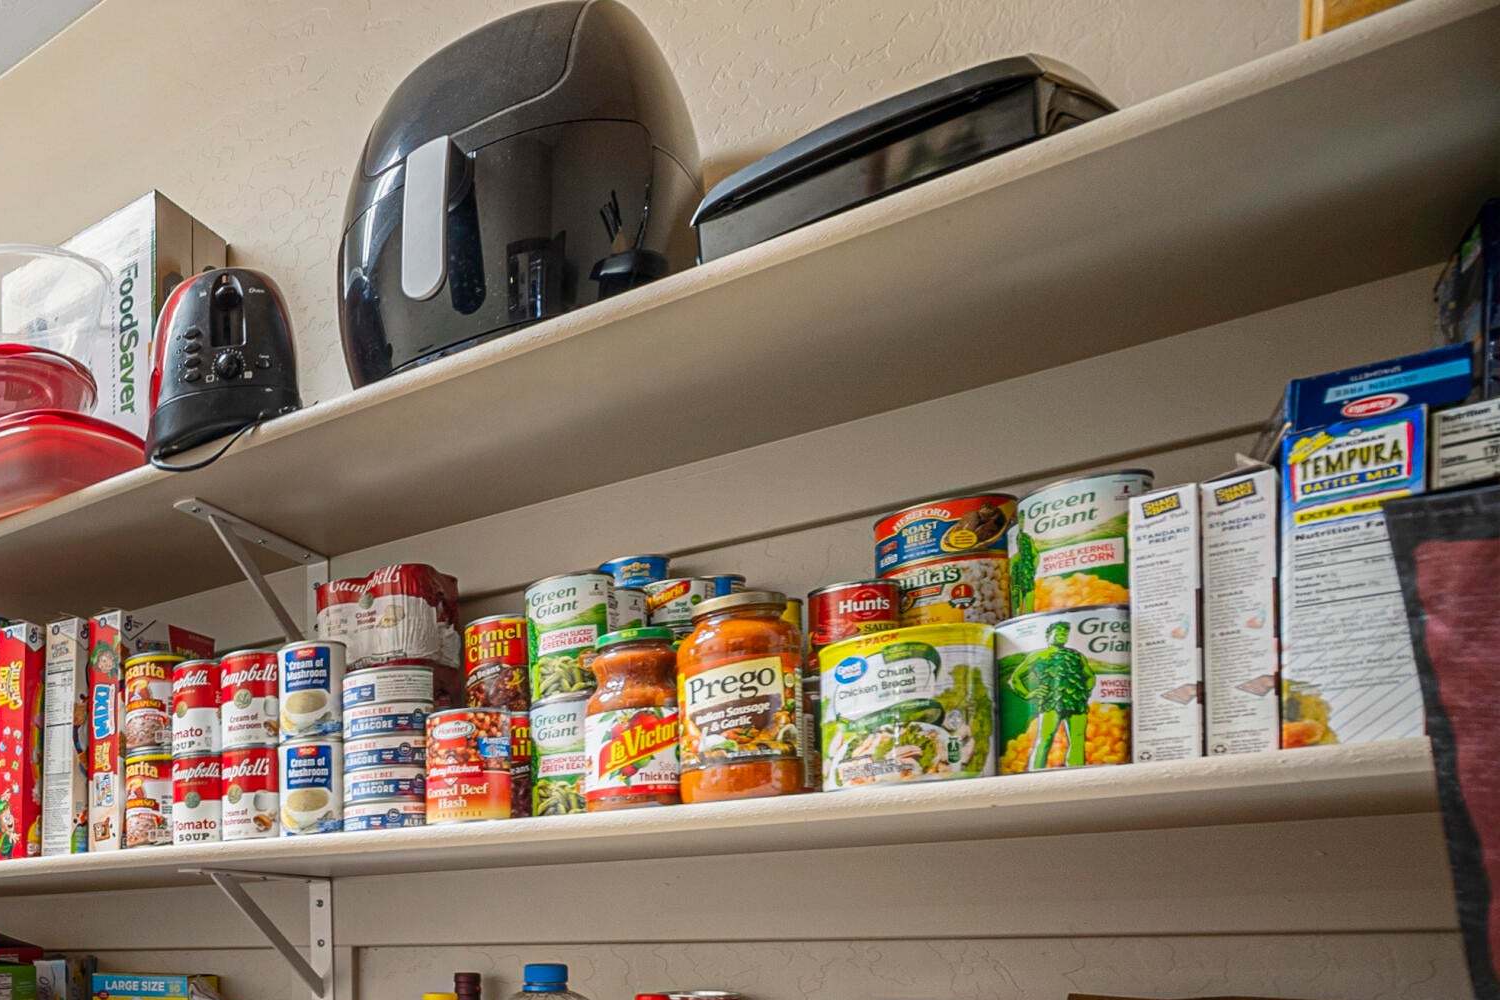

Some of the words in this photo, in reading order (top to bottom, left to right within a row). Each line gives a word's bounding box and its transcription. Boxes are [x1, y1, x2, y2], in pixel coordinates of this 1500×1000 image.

[119, 261, 139, 413] FoodSaver
[1301, 440, 1404, 482] TEMPURA
[1303, 474, 1360, 493] BATTER
[1366, 466, 1400, 481] MIX
[1027, 490, 1096, 520] Green
[902, 521, 938, 536] ROAST
[1033, 506, 1099, 535] Giant
[906, 531, 932, 544] BEEF
[1042, 552, 1071, 563] WHOLE
[1073, 542, 1116, 557] KERNEL
[1042, 559, 1079, 574] SWEET
[1081, 551, 1116, 566] CORN
[329, 564, 402, 594] Campbell's
[531, 585, 576, 607] Green
[536, 600, 578, 619] Giant
[839, 598, 890, 614] Hunt's
[465, 624, 522, 647] Hormel
[541, 639, 566, 650] GREEN
[568, 634, 594, 646] BEANS
[865, 632, 899, 646] PACK
[468, 643, 509, 663] Chili
[288, 661, 314, 670] Cream
[878, 665, 915, 679] Chunk
[221, 664, 278, 688] Campbell's
[286, 669, 327, 680] Mushroom
[9, 660, 23, 710] Charms
[689, 667, 776, 705] Prego
[839, 684, 878, 699] Chicken
[881, 676, 916, 690] Breast
[534, 710, 576, 730] Green
[696, 708, 725, 725] Italian
[726, 701, 770, 718] Sausage
[228, 723, 262, 732] Mushroom
[352, 719, 393, 731] ALBACORE
[720, 716, 752, 729] Garlic
[538, 724, 578, 741] Giant
[623, 720, 680, 753] Victor
[290, 758, 315, 768] Cream
[541, 761, 564, 772] GREEN
[173, 762, 220, 782] Campbell's
[288, 768, 329, 778] Mushroom
[639, 772, 664, 782] Thick
[353, 784, 394, 795] ALBACORE
[427, 786, 457, 799] Corned
[460, 783, 488, 794] Beef
[438, 796, 467, 809] Hash
[175, 818, 216, 831] Tomato
[179, 832, 210, 842] SOUP
[105, 980, 138, 992] LARGE
[141, 981, 165, 992] SIZE
